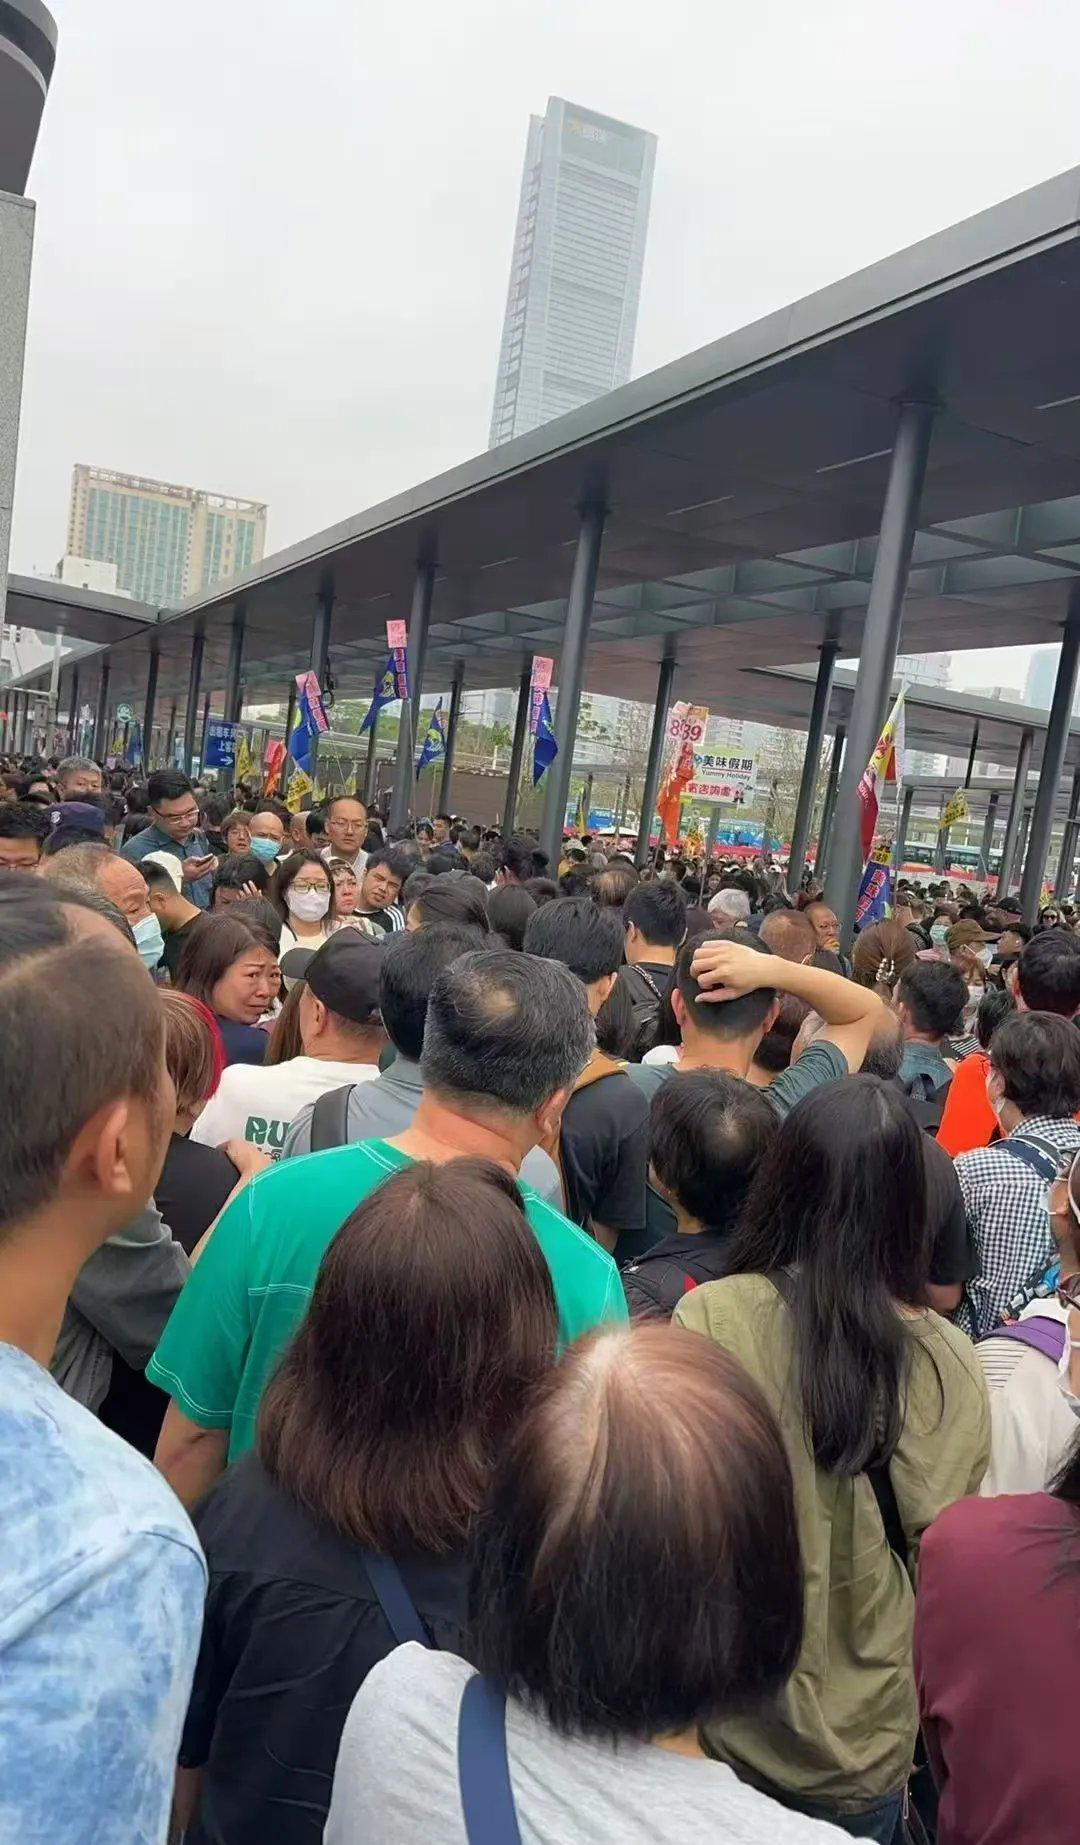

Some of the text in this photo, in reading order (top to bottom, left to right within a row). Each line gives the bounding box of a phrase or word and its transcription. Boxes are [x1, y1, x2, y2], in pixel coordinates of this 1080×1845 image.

[702, 755, 753, 771] 美味假期
[702, 769, 751, 781] Yummy Holiday
